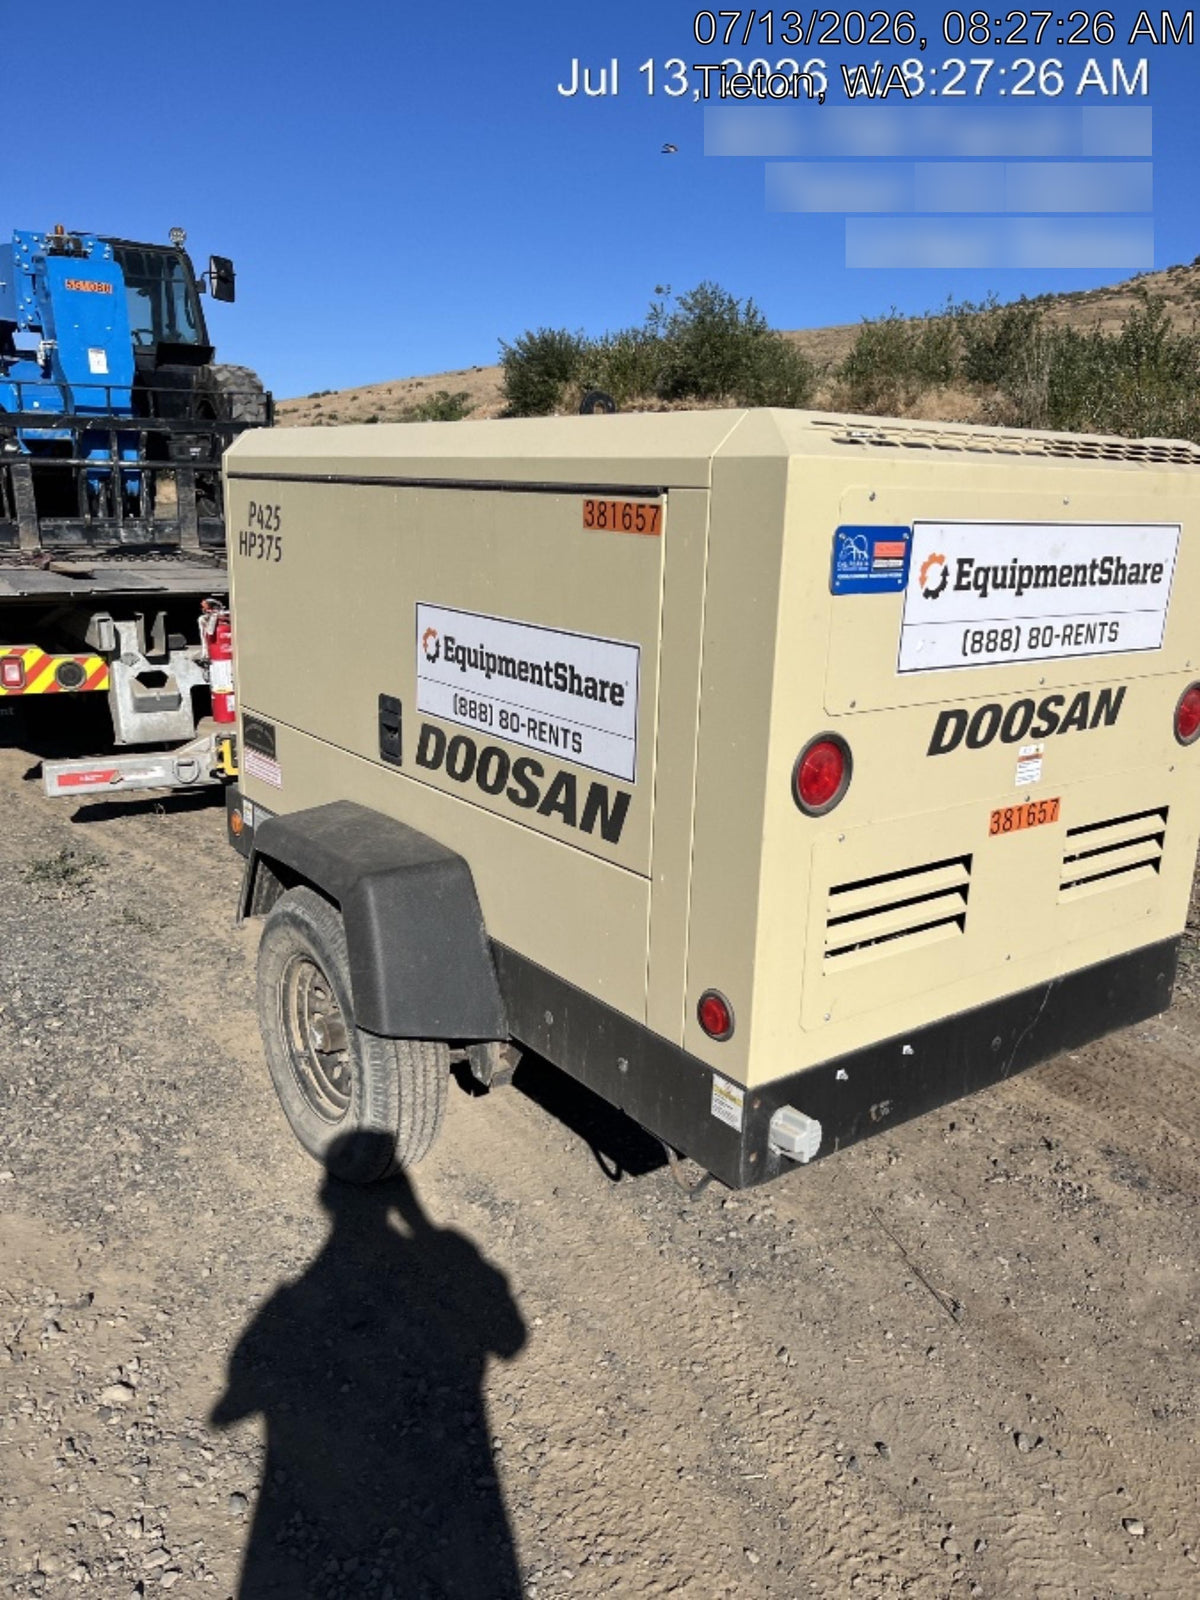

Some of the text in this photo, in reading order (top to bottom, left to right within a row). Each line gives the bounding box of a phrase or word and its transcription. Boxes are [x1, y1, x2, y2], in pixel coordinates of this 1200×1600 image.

[248, 501, 281, 532] P425
[584, 499, 661, 532] 381657
[239, 531, 282, 562] HP375
[953, 556, 1164, 598] EquipmentShare
[962, 621, 1120, 656] (888) 80-RENTS
[443, 635, 626, 708] EquipmentShare
[452, 692, 583, 755] (888) 80-RENTS
[927, 685, 1128, 757] DOOSAN
[415, 722, 632, 845] DOOSAN
[989, 798, 1060, 835] 381657
